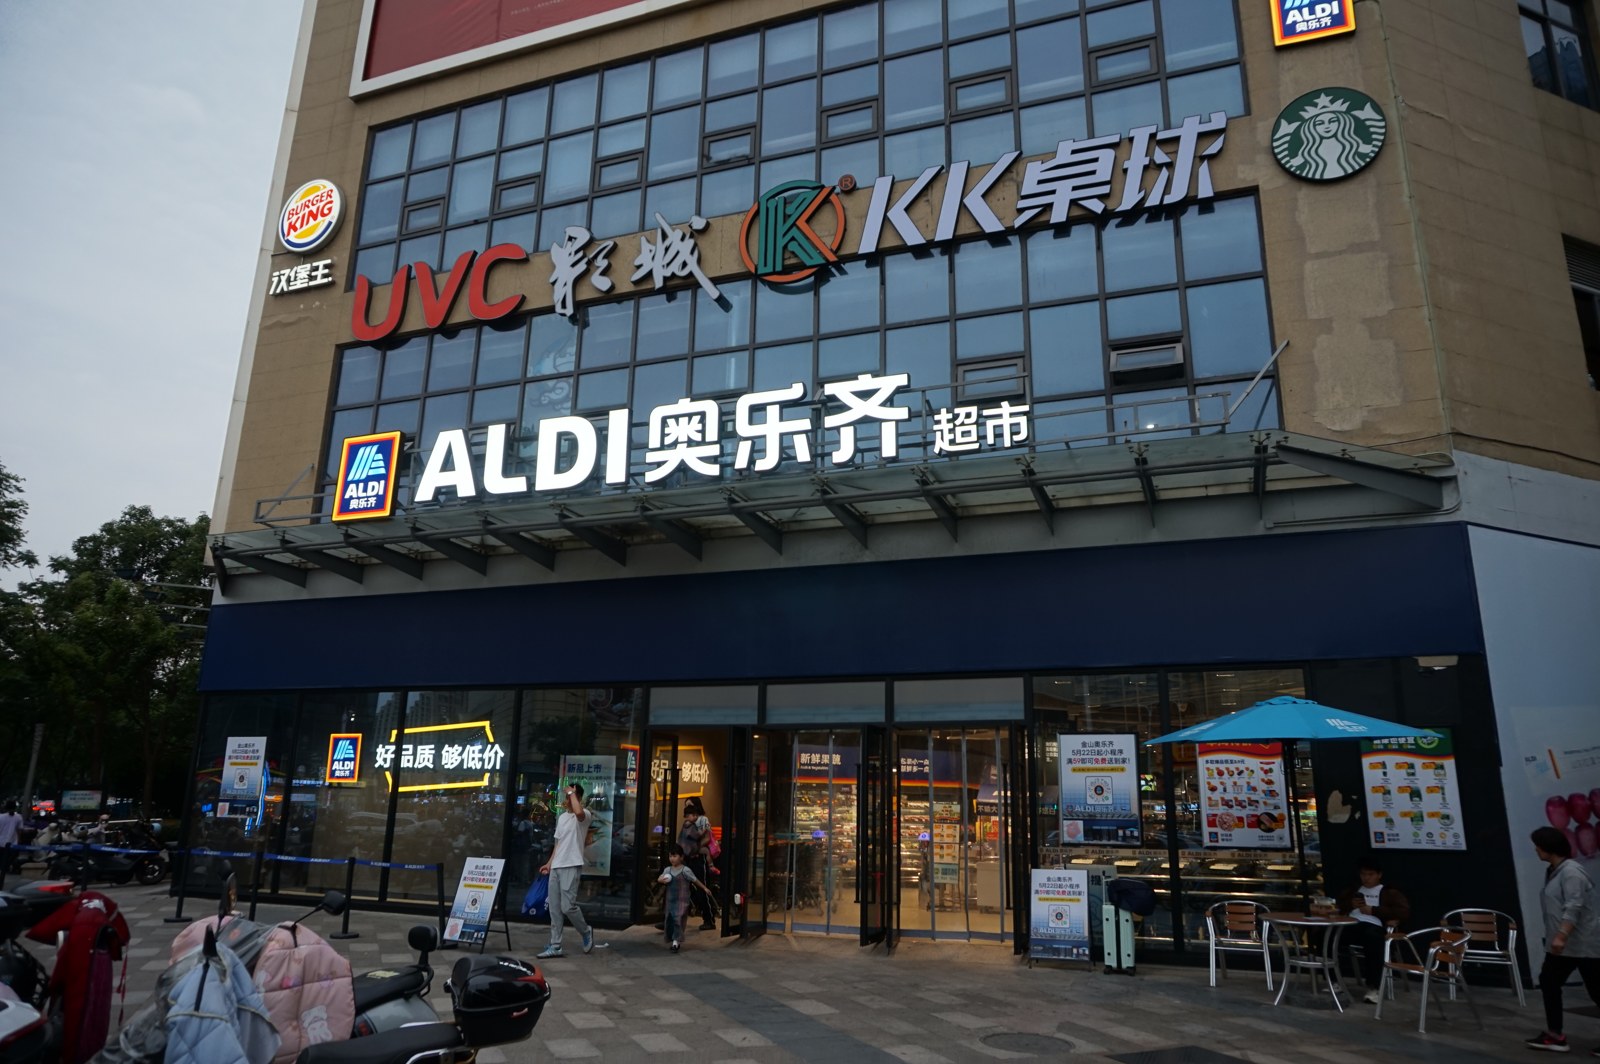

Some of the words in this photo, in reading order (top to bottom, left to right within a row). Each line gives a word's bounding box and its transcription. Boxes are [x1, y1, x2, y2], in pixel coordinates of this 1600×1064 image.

[1285, 0, 1340, 25] ALDI
[1295, 16, 1332, 33] 奥乐齐
[287, 189, 333, 222] BURGER
[286, 200, 334, 238] KING
[549, 212, 721, 317] 影城
[269, 259, 332, 295] 汉堡王
[352, 242, 527, 342] UVC
[933, 400, 1030, 455] 超市
[344, 479, 386, 499] ALDI
[349, 497, 377, 510] 奥乐齐
[1072, 748, 1125, 757] 5月22日起小程序
[1081, 740, 1115, 749] 金山奥乐齐
[332, 760, 354, 771] ALDI
[374, 743, 435, 771] 好品质
[440, 742, 505, 772] 够低价
[567, 763, 602, 774] 新品上市
[800, 753, 842, 765] 新鲜果蔬
[682, 761, 709, 784] 够低价
